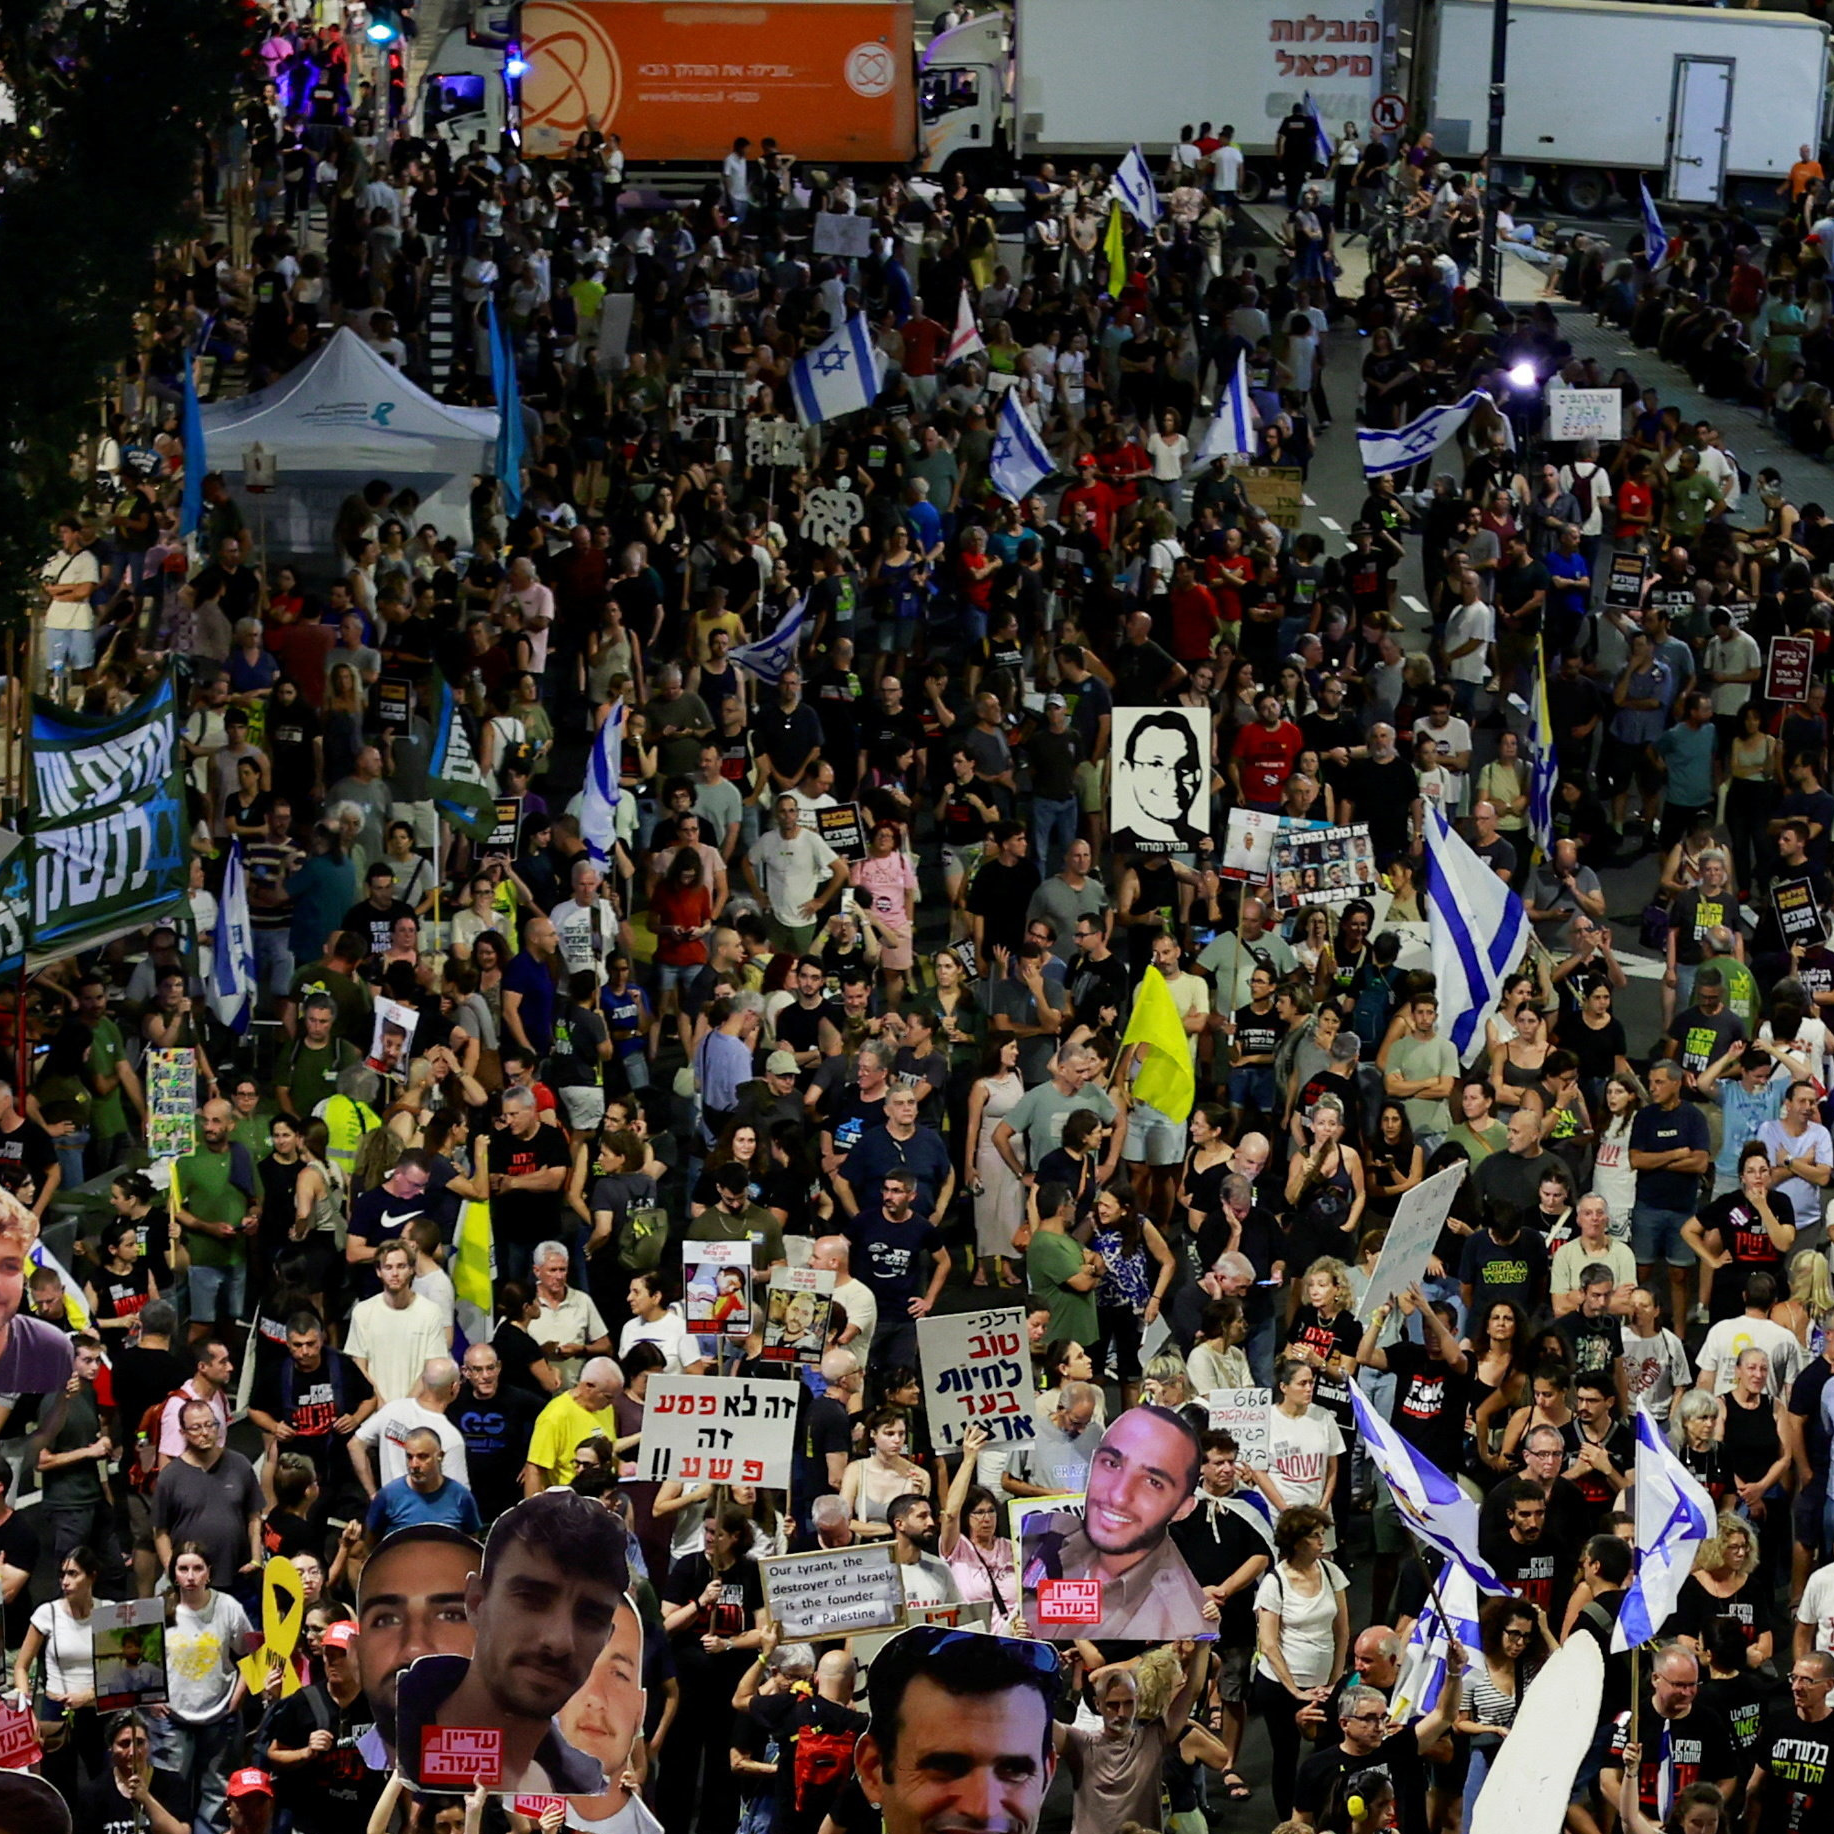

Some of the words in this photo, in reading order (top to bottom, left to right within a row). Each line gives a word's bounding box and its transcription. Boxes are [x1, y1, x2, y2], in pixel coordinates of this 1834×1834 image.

[1268, 14, 1380, 43] הובלות
[1275, 49, 1372, 77] מיכאל
[34, 800, 150, 926] לנשק
[968, 1330, 1020, 1359] טוב
[936, 1358, 1023, 1394] לחיות
[724, 1384, 757, 1417] לא
[765, 1396, 796, 1419] זה
[957, 1390, 1021, 1417] בעד
[1234, 1389, 1268, 1408] 666
[698, 1428, 734, 1450] זה
[1276, 1453, 1324, 1479] NOW!
[769, 1566, 792, 1577] Our
[798, 1560, 838, 1576] tyrant,
[844, 1556, 863, 1568] the
[773, 1577, 829, 1596] destroyer
[835, 1574, 847, 1587] of
[857, 1569, 894, 1584] Israel,
[1056, 1583, 1096, 1599] עדיין
[785, 1600, 795, 1611] is
[803, 1596, 822, 1609] the
[828, 1590, 874, 1606] founder
[1047, 1602, 1096, 1616] בעזה.
[802, 1614, 814, 1626] of
[823, 1608, 876, 1624] Palestine
[446, 1732, 497, 1750] עדיין
[431, 1755, 496, 1773] בעזה.
